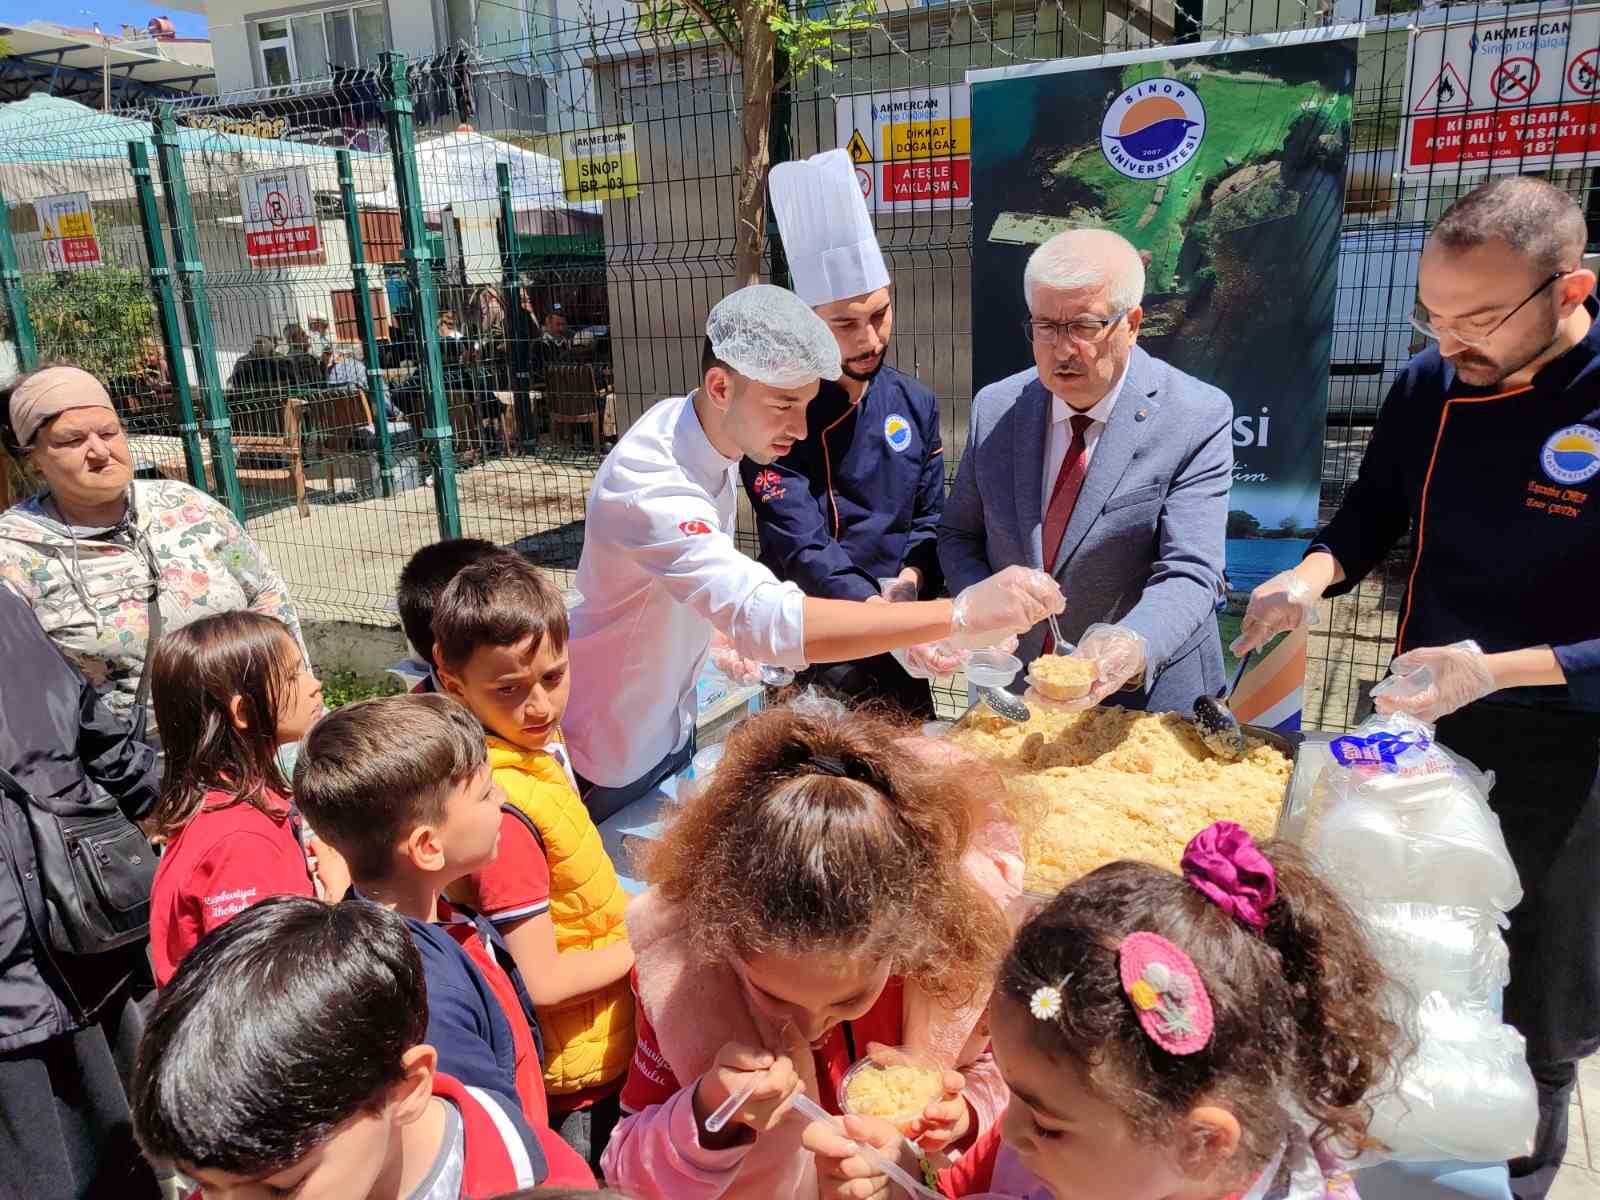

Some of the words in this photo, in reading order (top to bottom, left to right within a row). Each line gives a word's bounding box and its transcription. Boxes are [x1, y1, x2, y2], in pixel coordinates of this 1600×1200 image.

[1482, 22, 1570, 42] AKMERCAN
[1481, 42, 1512, 56] Sinp
[880, 99, 938, 113] AKMERCAN
[1425, 134, 1461, 150] AÇIK
[1476, 149, 1512, 158] TELFON
[902, 166, 950, 181] ATEŞLE
